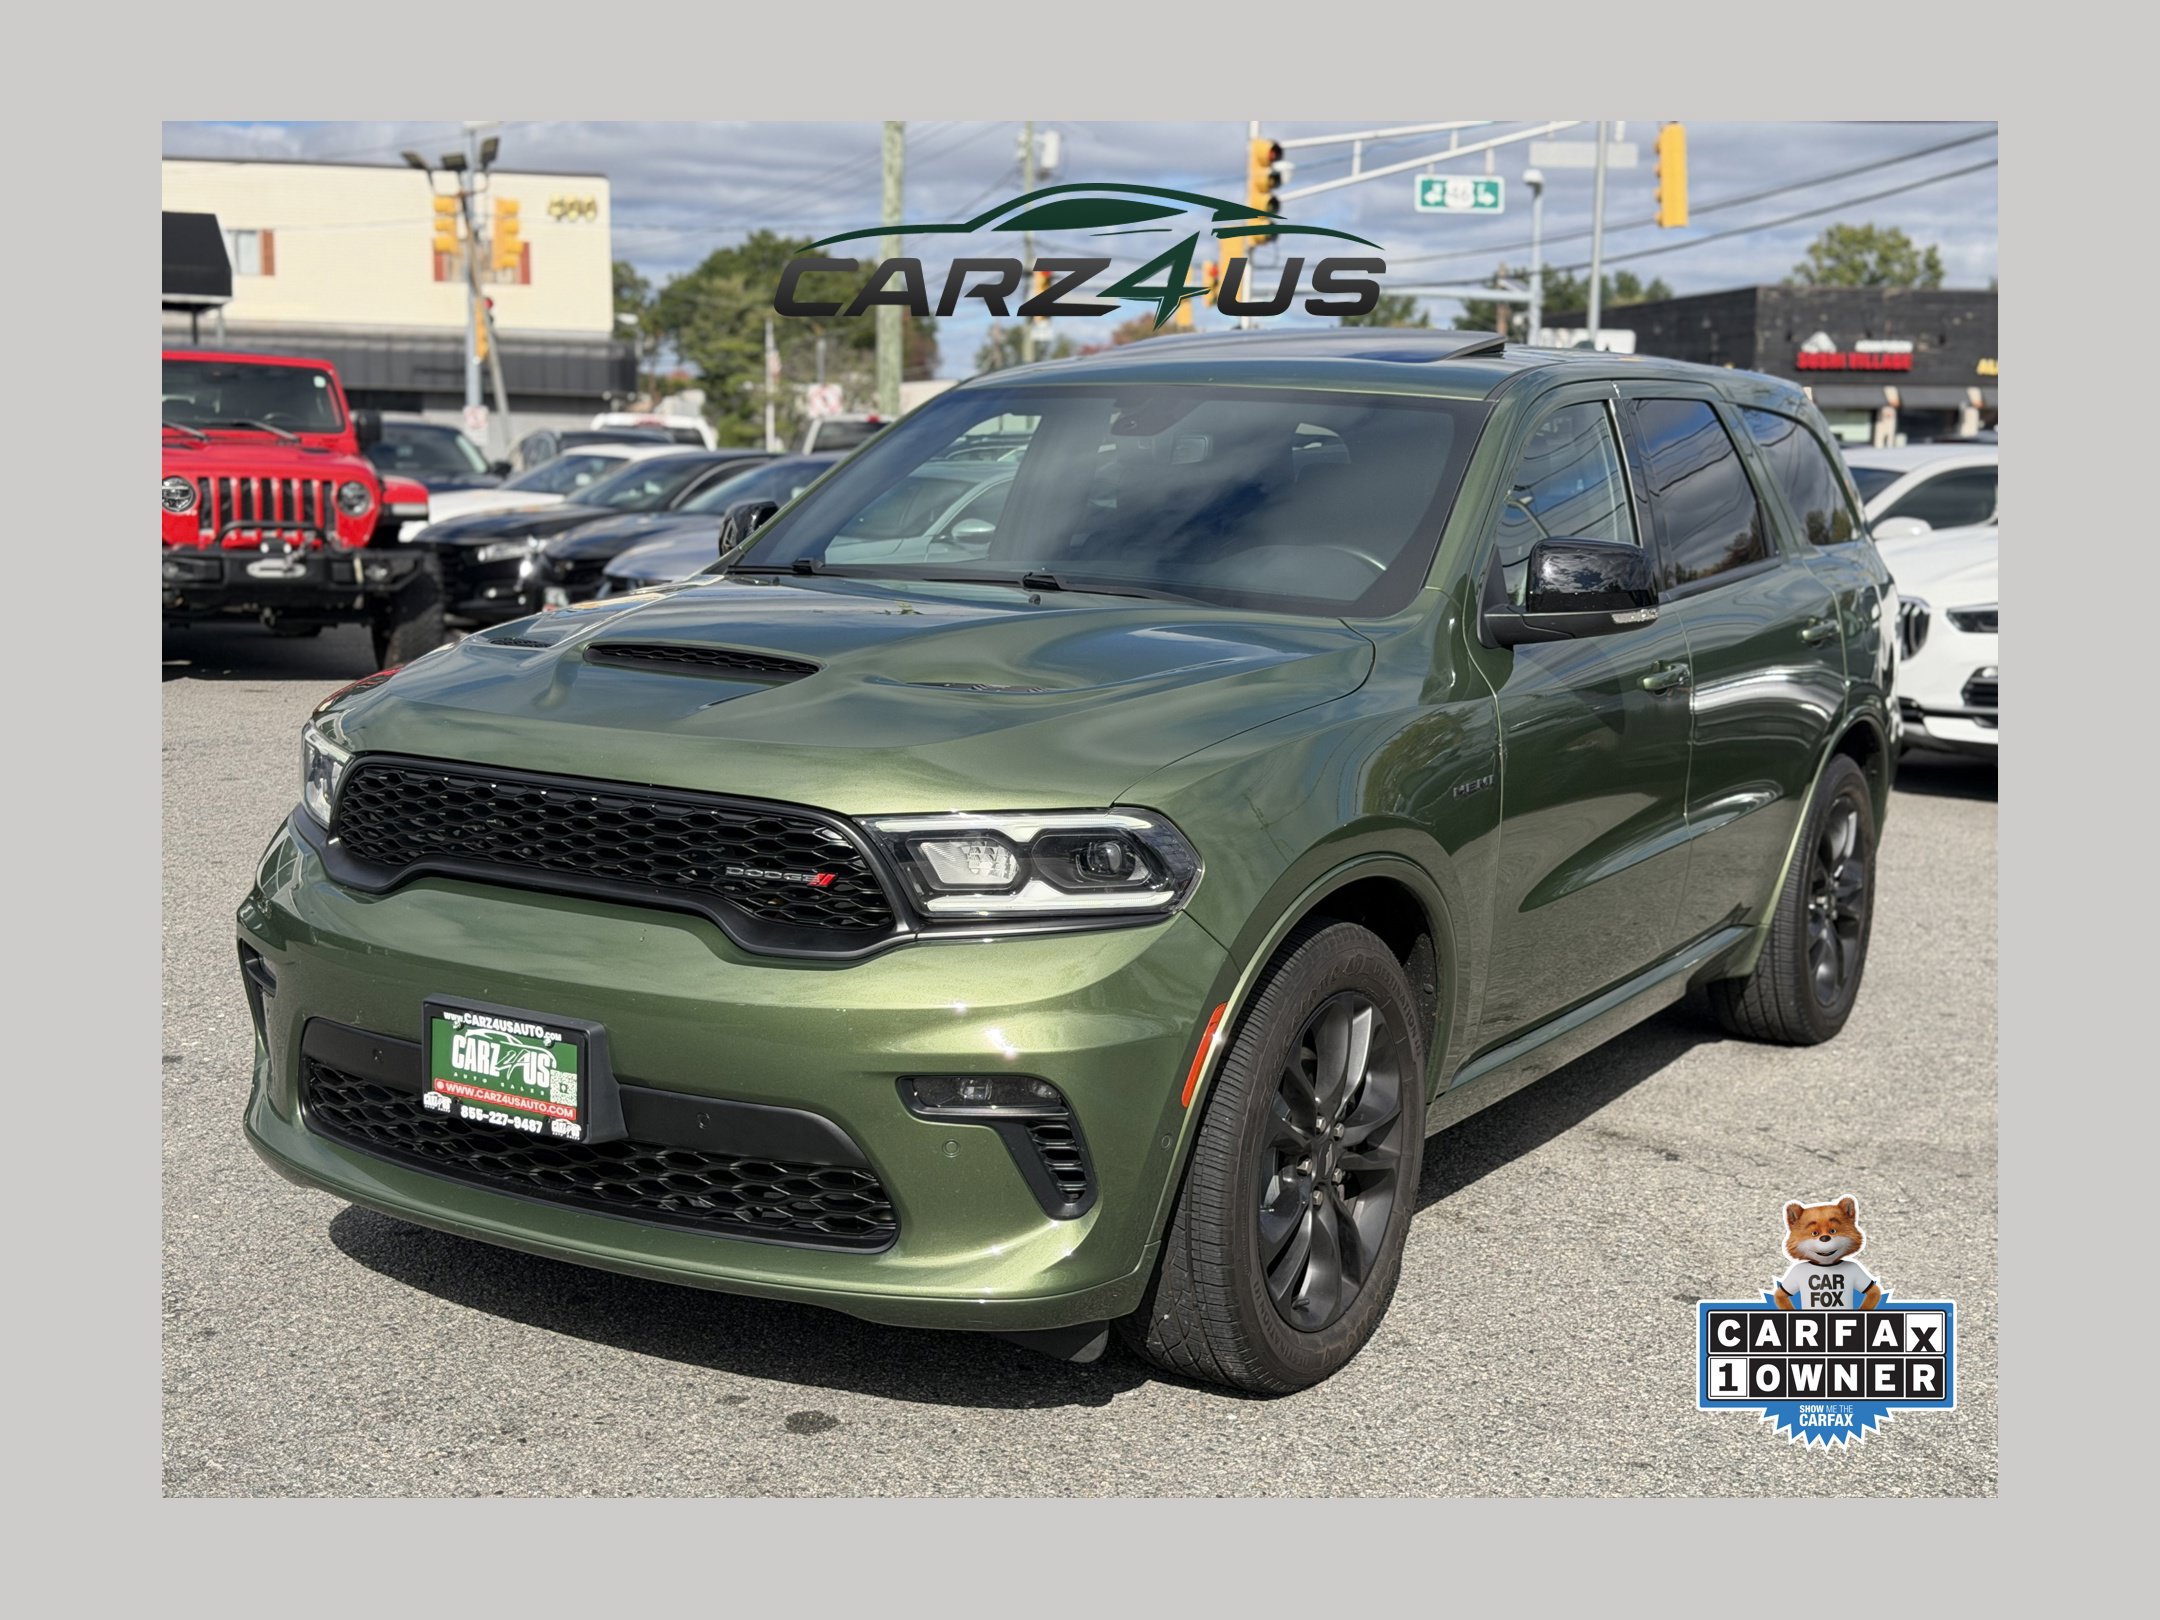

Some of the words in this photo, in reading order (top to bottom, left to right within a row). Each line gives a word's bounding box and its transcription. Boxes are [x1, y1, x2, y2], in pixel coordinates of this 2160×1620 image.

[725, 866, 820, 883] DODGE
[446, 1082, 573, 1118] WWW.CARZ4USAUTO.COM
[460, 1105, 543, 1134] 855-227-9487
